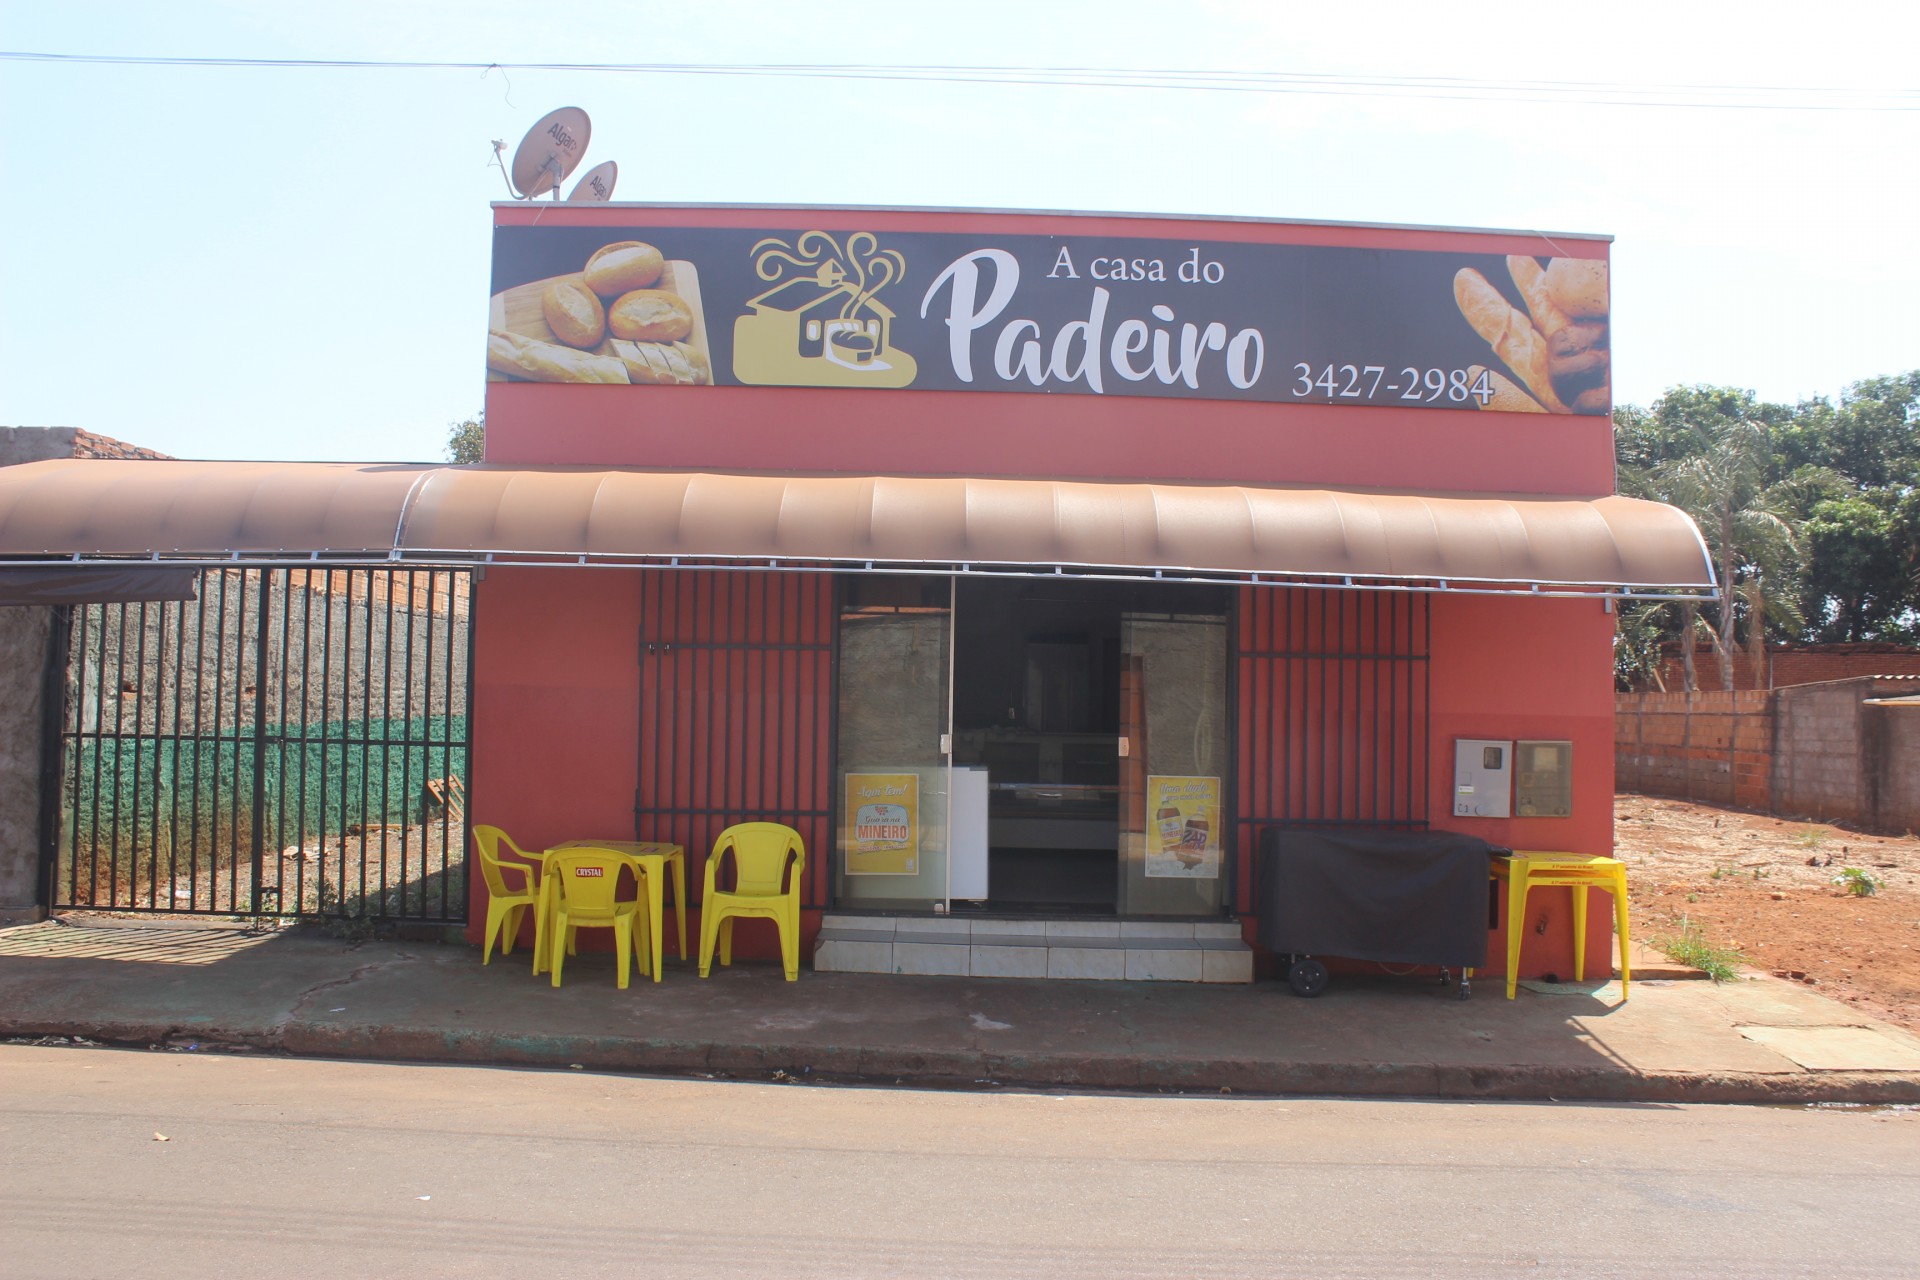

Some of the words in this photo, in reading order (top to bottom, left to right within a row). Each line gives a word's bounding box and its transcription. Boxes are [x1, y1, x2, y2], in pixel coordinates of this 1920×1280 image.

[1046, 246, 1080, 278] A
[1090, 257, 1166, 282] casa
[1178, 248, 1224, 284] do
[920, 248, 1264, 393] Padeiro
[1292, 362, 1494, 404] 3427-2984
[858, 825, 907, 840] MINEIRO
[576, 868, 602, 877] CRYSTAL
